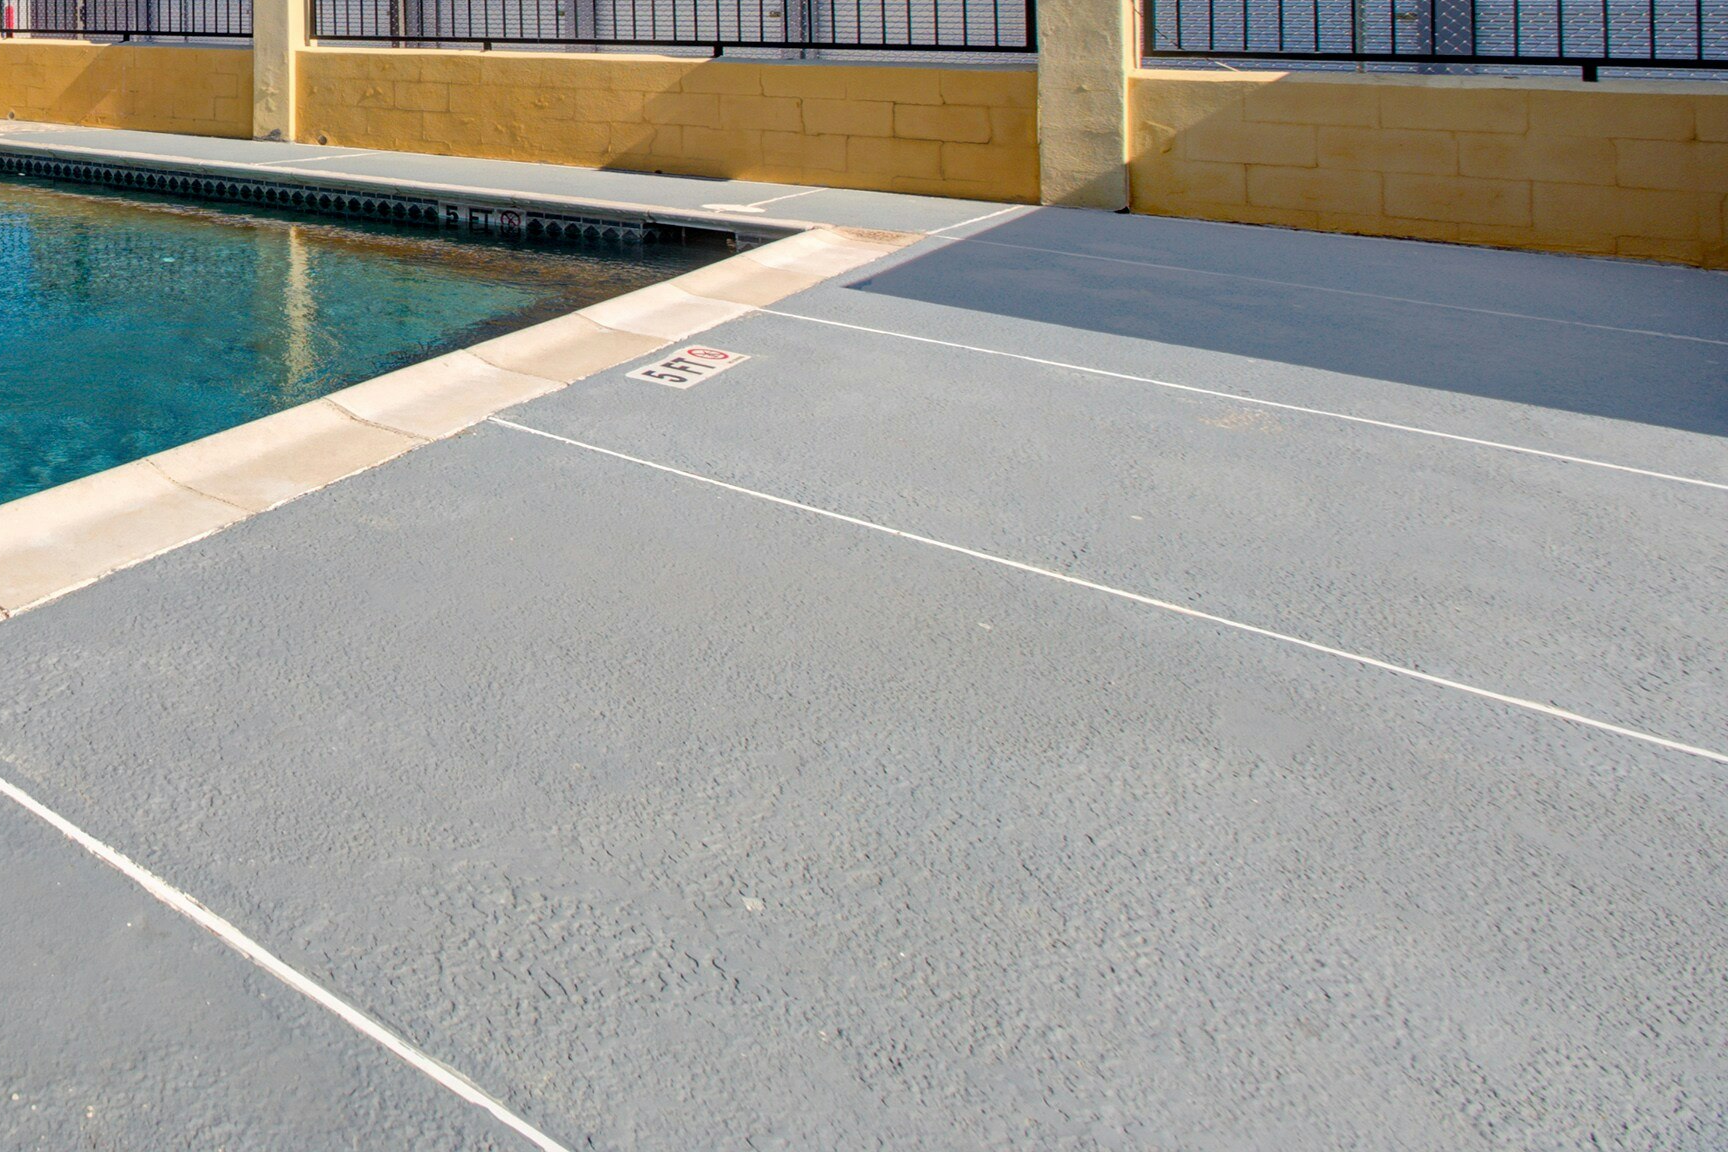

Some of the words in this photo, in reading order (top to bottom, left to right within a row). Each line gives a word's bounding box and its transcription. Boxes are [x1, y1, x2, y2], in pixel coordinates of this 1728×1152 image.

[446, 205, 459, 223] 5
[469, 207, 494, 224] FT
[660, 357, 716, 375] FT
[641, 370, 688, 383] 5
